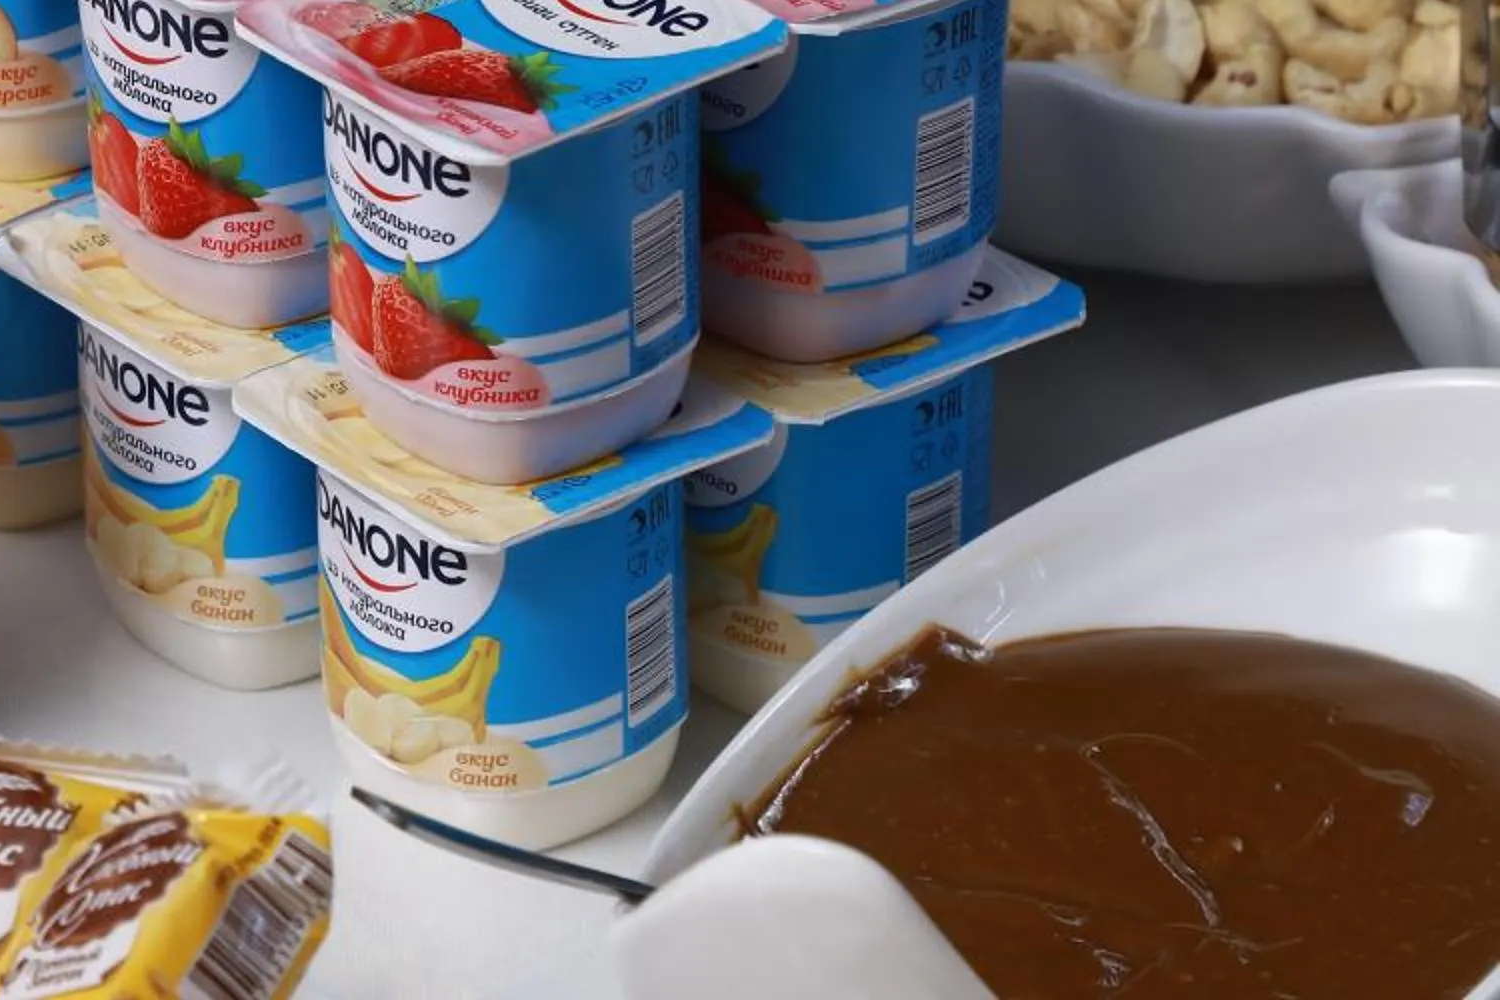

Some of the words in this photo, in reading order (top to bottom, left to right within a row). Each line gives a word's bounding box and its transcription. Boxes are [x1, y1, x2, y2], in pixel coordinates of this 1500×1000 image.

[113, 78, 172, 113] молока
[223, 219, 276, 239] вкус
[352, 208, 408, 251] молока
[200, 233, 303, 258] клубника
[457, 367, 512, 384] вкус
[434, 382, 540, 408] клубника
[102, 435, 155, 474] молока
[197, 585, 246, 606] вкус
[191, 600, 254, 622] банан
[350, 599, 406, 641] молока
[456, 752, 509, 772] вкус
[449, 768, 518, 788] банан
